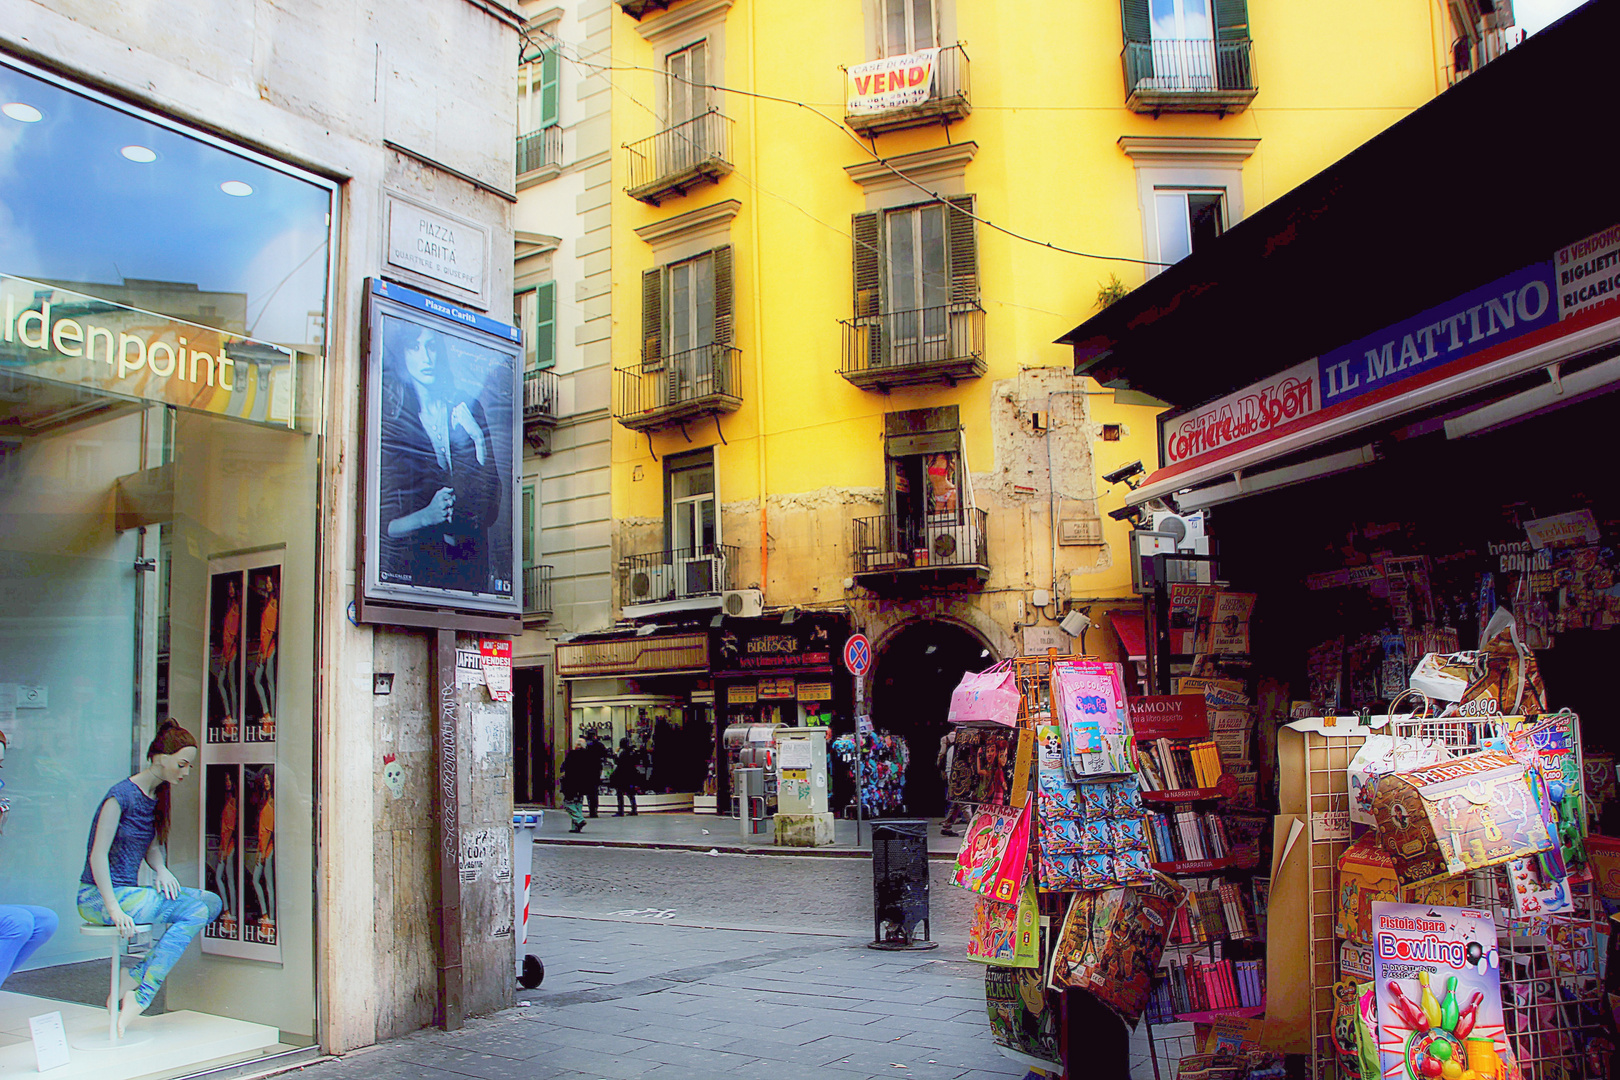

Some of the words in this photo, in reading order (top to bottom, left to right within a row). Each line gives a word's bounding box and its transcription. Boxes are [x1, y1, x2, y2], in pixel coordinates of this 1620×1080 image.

[419, 219, 456, 245] PIAZZA
[394, 249, 433, 270] QUARTIERE
[1560, 248, 1569, 266] SI
[424, 298, 451, 316] Piazza
[451, 308, 477, 325] Carità
[1325, 359, 1360, 399] IL
[1364, 280, 1550, 384] MATTINO
[1168, 408, 1233, 462] Corriere
[1259, 376, 1313, 430] Sport
[1487, 541, 1530, 555] home
[1173, 587, 1216, 597] PUZZLE
[1173, 596, 1197, 605] GIGA
[481, 656, 510, 666] VENDESI
[1087, 681, 1111, 697] COLOR
[1078, 698, 1096, 712] Peppa
[1096, 698, 1107, 711] Pig
[1162, 714, 1183, 722] aperto
[209, 727, 238, 742] HUE
[1415, 764, 1471, 787] PETER
[1469, 753, 1507, 775] PAN
[1182, 861, 1213, 869] NARRATIVA
[207, 921, 237, 939] HUE
[1380, 916, 1415, 930] Pistola
[1416, 918, 1446, 932] Spara
[245, 925, 275, 943] HUE
[1341, 946, 1372, 965] TOYS
[1379, 934, 1465, 967] Bowling
[1341, 960, 1372, 972] COLLECTION
[1390, 964, 1437, 974] DIVERTIMENTO
[986, 981, 1015, 998] ALIEN
